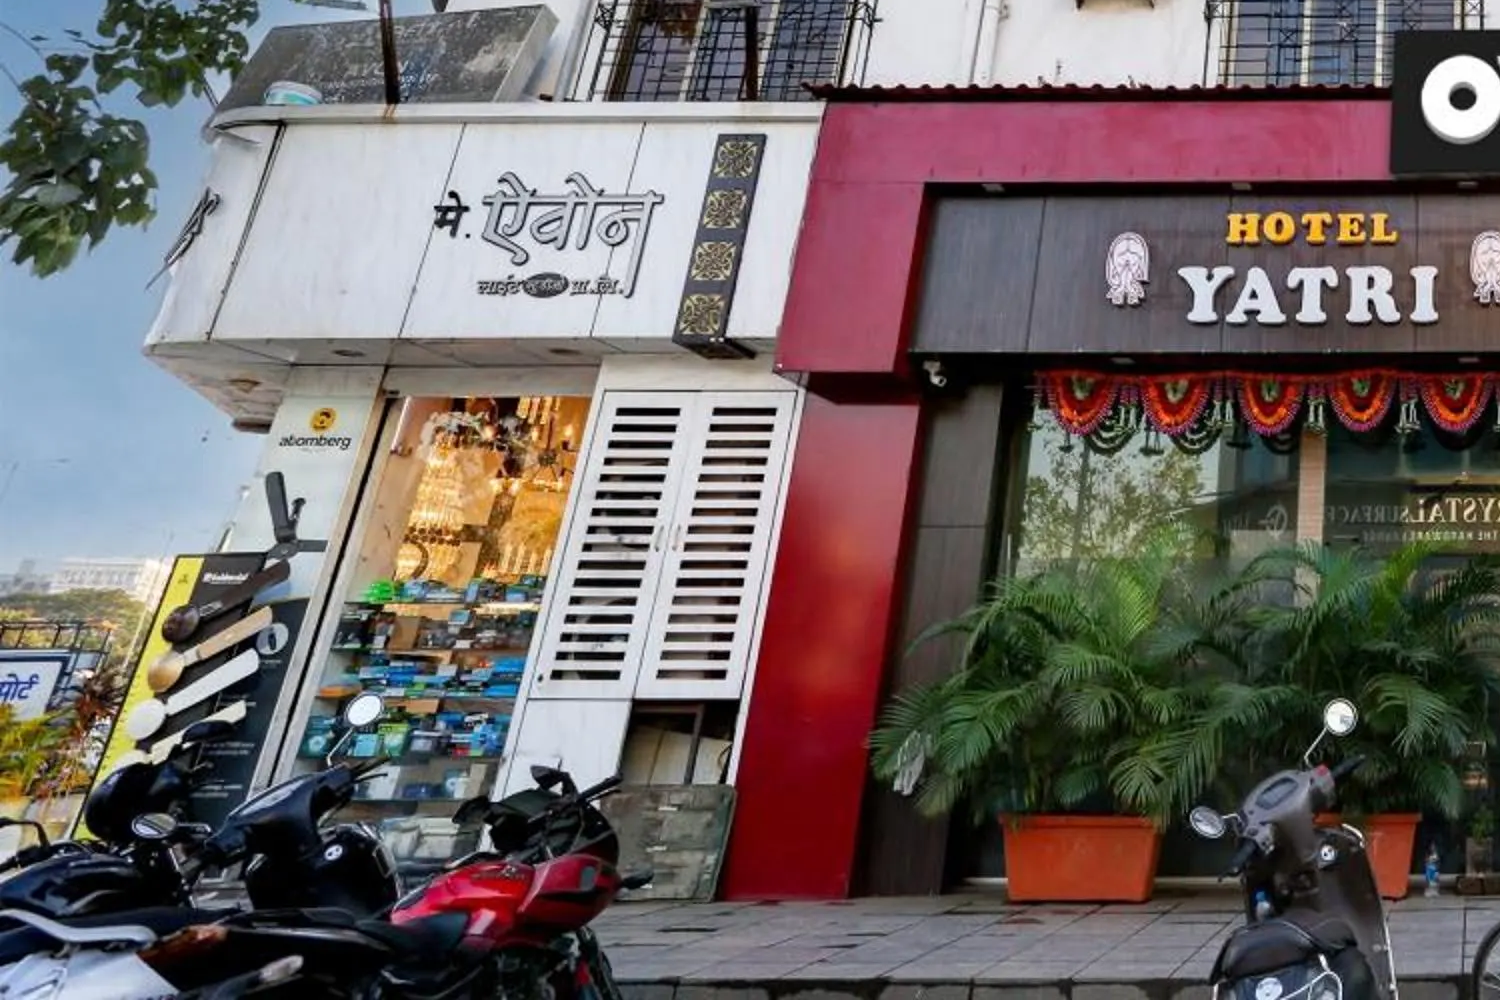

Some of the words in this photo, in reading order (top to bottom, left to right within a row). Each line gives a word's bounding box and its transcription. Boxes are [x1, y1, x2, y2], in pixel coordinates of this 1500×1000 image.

[481, 171, 665, 299] ऐवोन
[1226, 211, 1399, 245] HOTEL
[1177, 265, 1439, 324] YATRI
[279, 433, 352, 451] atomberg
